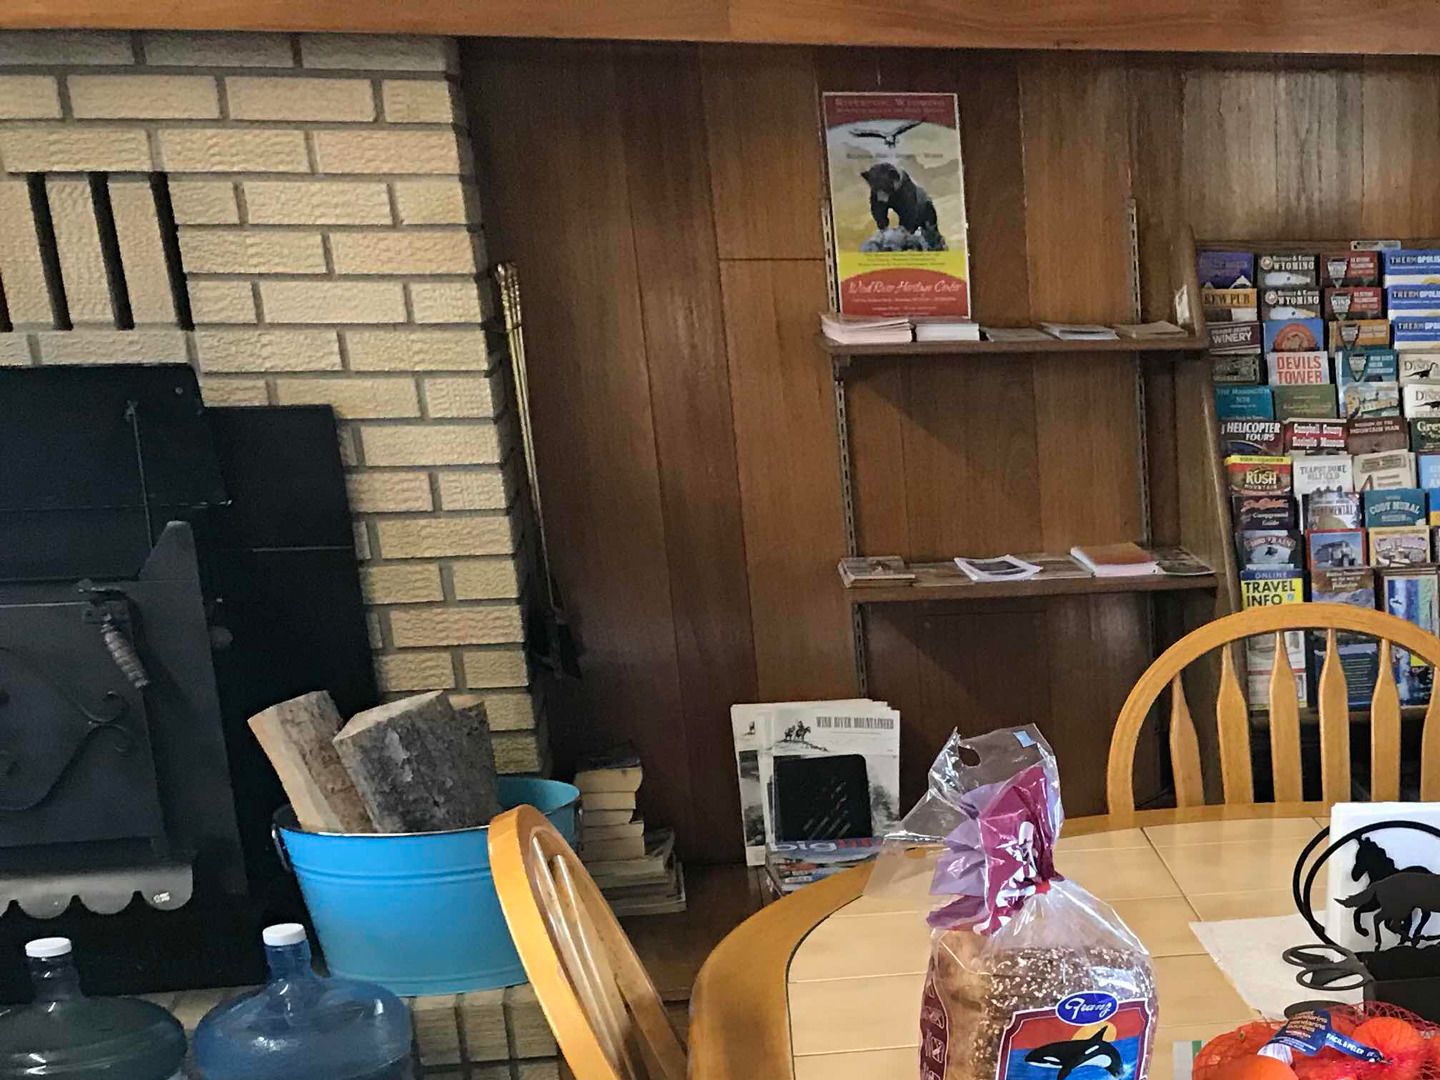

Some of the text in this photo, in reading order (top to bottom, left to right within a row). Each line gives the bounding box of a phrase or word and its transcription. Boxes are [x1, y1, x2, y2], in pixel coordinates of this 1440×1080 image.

[1273, 261, 1314, 271] WYOMING
[1278, 296, 1319, 305] WYOMING
[1213, 331, 1252, 344] WINERY
[1277, 355, 1321, 370] DEVILS
[1277, 371, 1322, 384] TOWER
[1226, 421, 1281, 434] HELICOPTER
[1245, 433, 1275, 442] TOURS
[1246, 471, 1277, 484] RUSH
[1255, 571, 1288, 579] ONLINE
[1244, 581, 1296, 593] TRAVEL
[1246, 594, 1283, 607] INFO
[1064, 997, 1113, 1021] Franz
